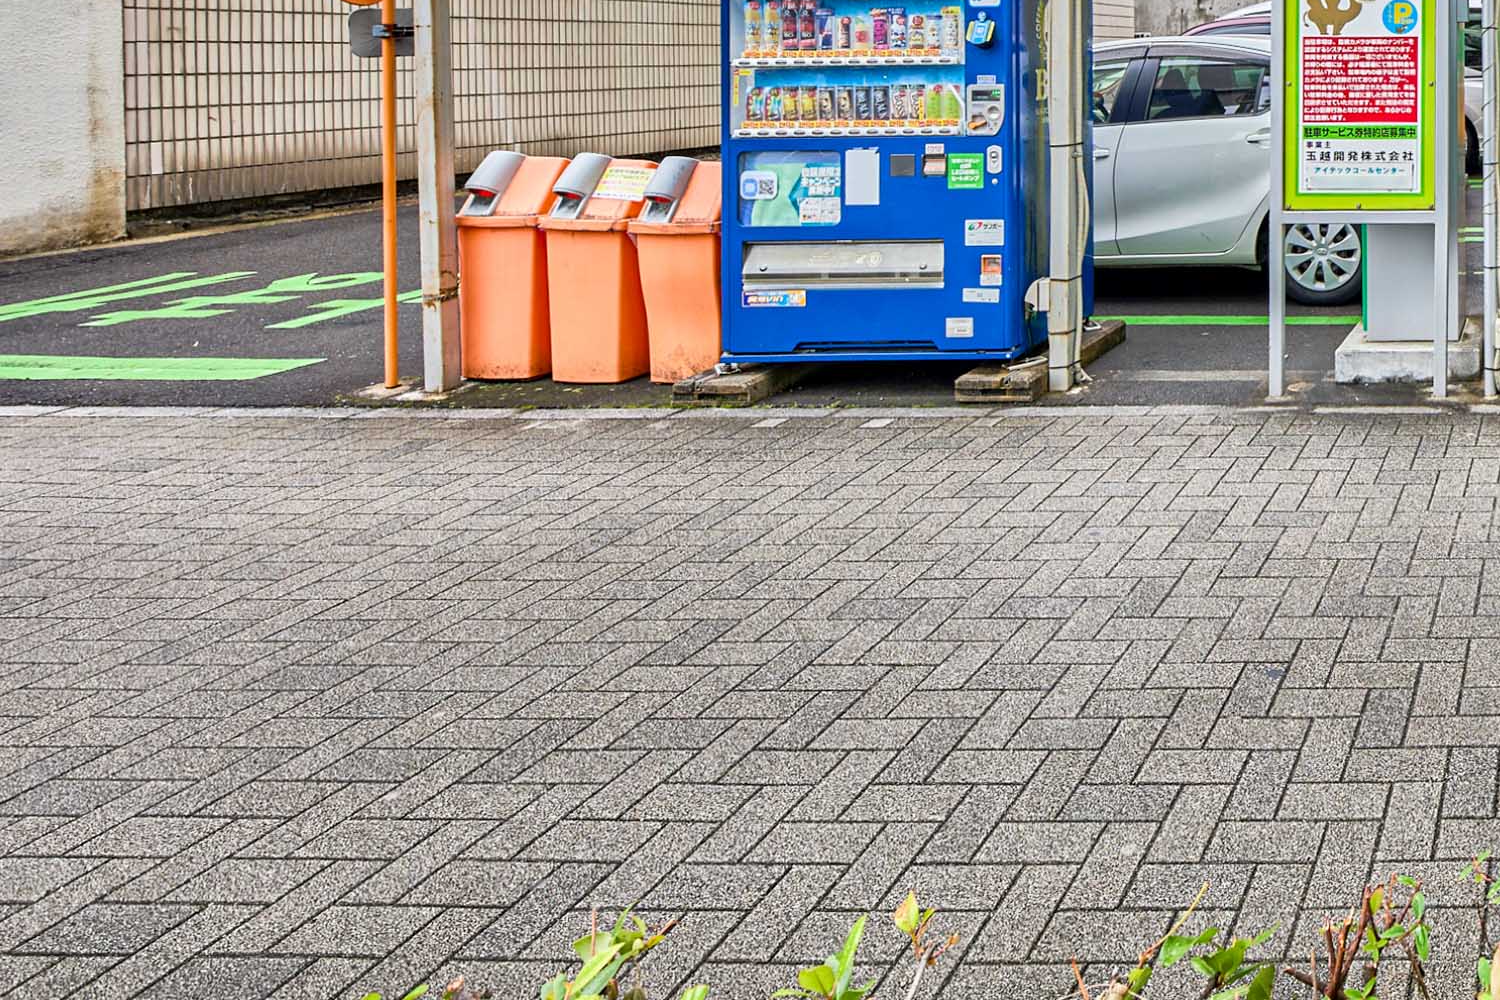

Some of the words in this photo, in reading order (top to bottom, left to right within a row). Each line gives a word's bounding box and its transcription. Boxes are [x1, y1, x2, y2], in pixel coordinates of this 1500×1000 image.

[1306, 151, 1414, 161] 玉越開発株式会社
